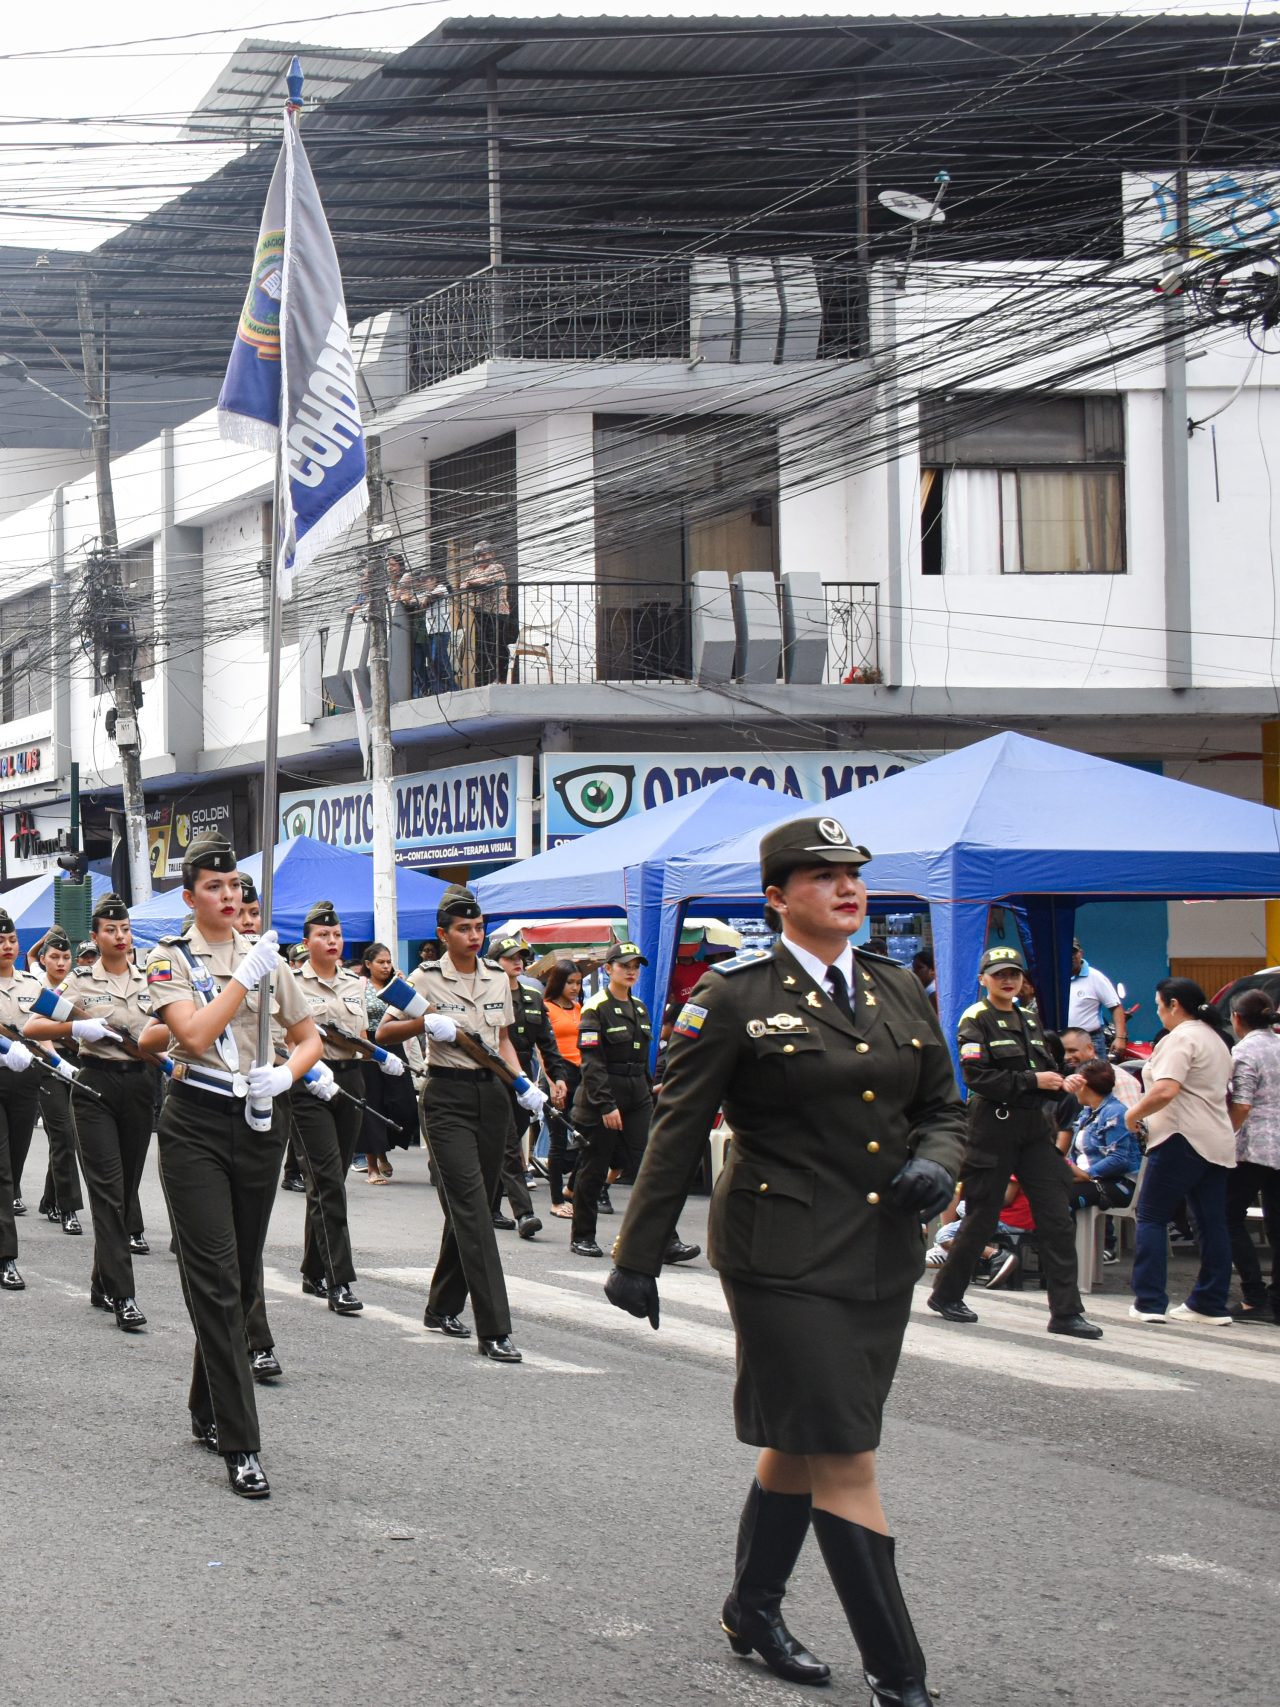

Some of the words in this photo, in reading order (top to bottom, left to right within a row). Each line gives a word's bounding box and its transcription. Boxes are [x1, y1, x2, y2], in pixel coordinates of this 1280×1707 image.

[16, 748, 41, 775] KIDS
[192, 805, 229, 824] GOLDEN
[318, 792, 374, 847] OPTIC
[396, 771, 510, 841] MEGALENS
[491, 842, 513, 852] VISUAL
[168, 863, 182, 873] TALLE
